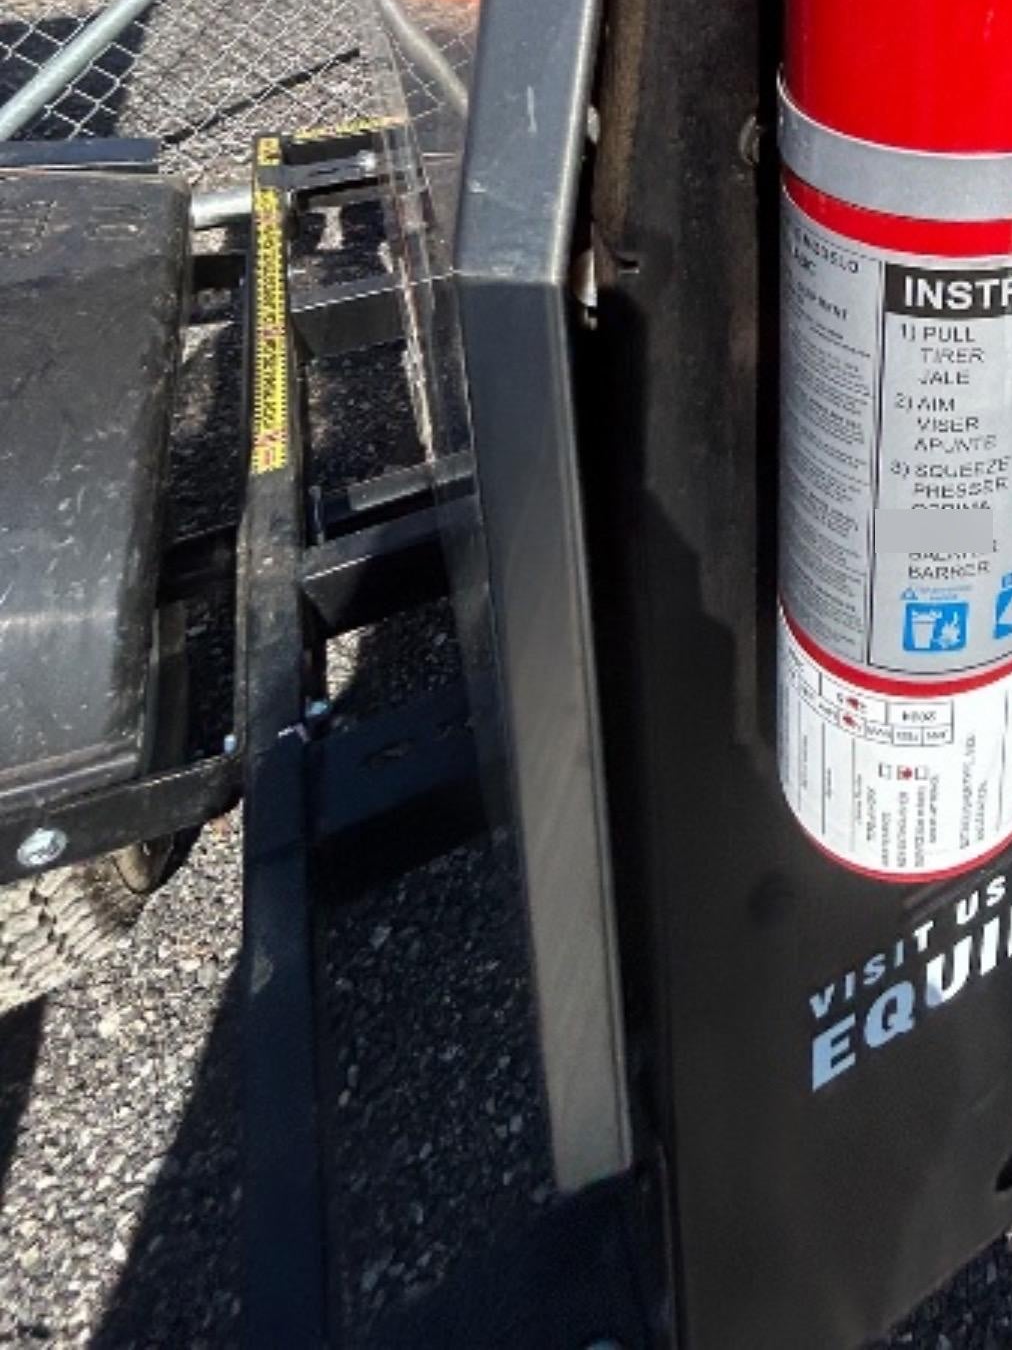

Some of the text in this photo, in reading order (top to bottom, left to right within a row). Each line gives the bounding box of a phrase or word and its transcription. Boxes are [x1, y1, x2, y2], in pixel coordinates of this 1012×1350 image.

[923, 326, 975, 343] PULL
[920, 347, 985, 364] TIRER
[919, 370, 970, 385] JALE
[918, 398, 955, 412] AIM
[917, 416, 979, 433] VISER
[914, 454, 1012, 479] SQUEEZE
[809, 920, 935, 1019] VISIT
[955, 875, 1007, 925] US
